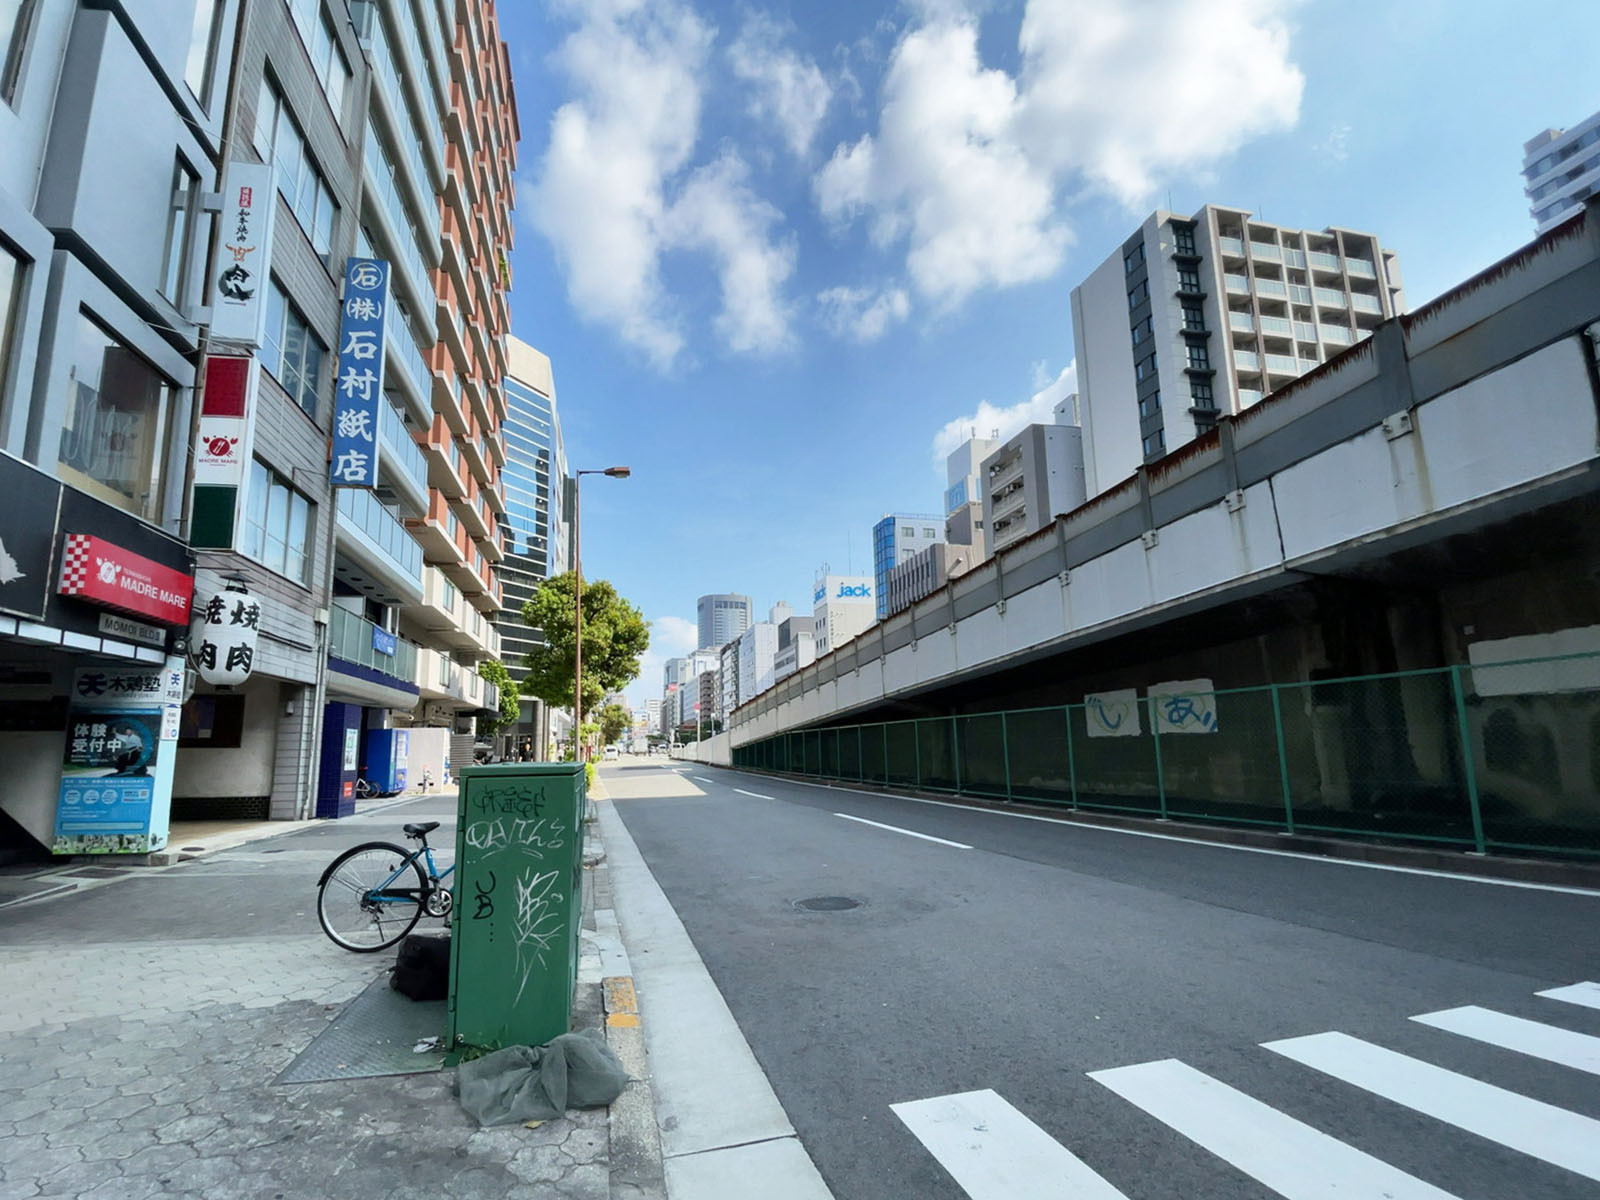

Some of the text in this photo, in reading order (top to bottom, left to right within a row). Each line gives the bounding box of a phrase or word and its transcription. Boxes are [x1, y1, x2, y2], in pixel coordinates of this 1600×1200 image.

[120, 575, 159, 600] MADRE
[159, 590, 187, 609] MARE
[837, 582, 871, 598] jack
[225, 600, 260, 673] 焼肉
[74, 723, 107, 738] 体験
[72, 739, 121, 753] 受付中
